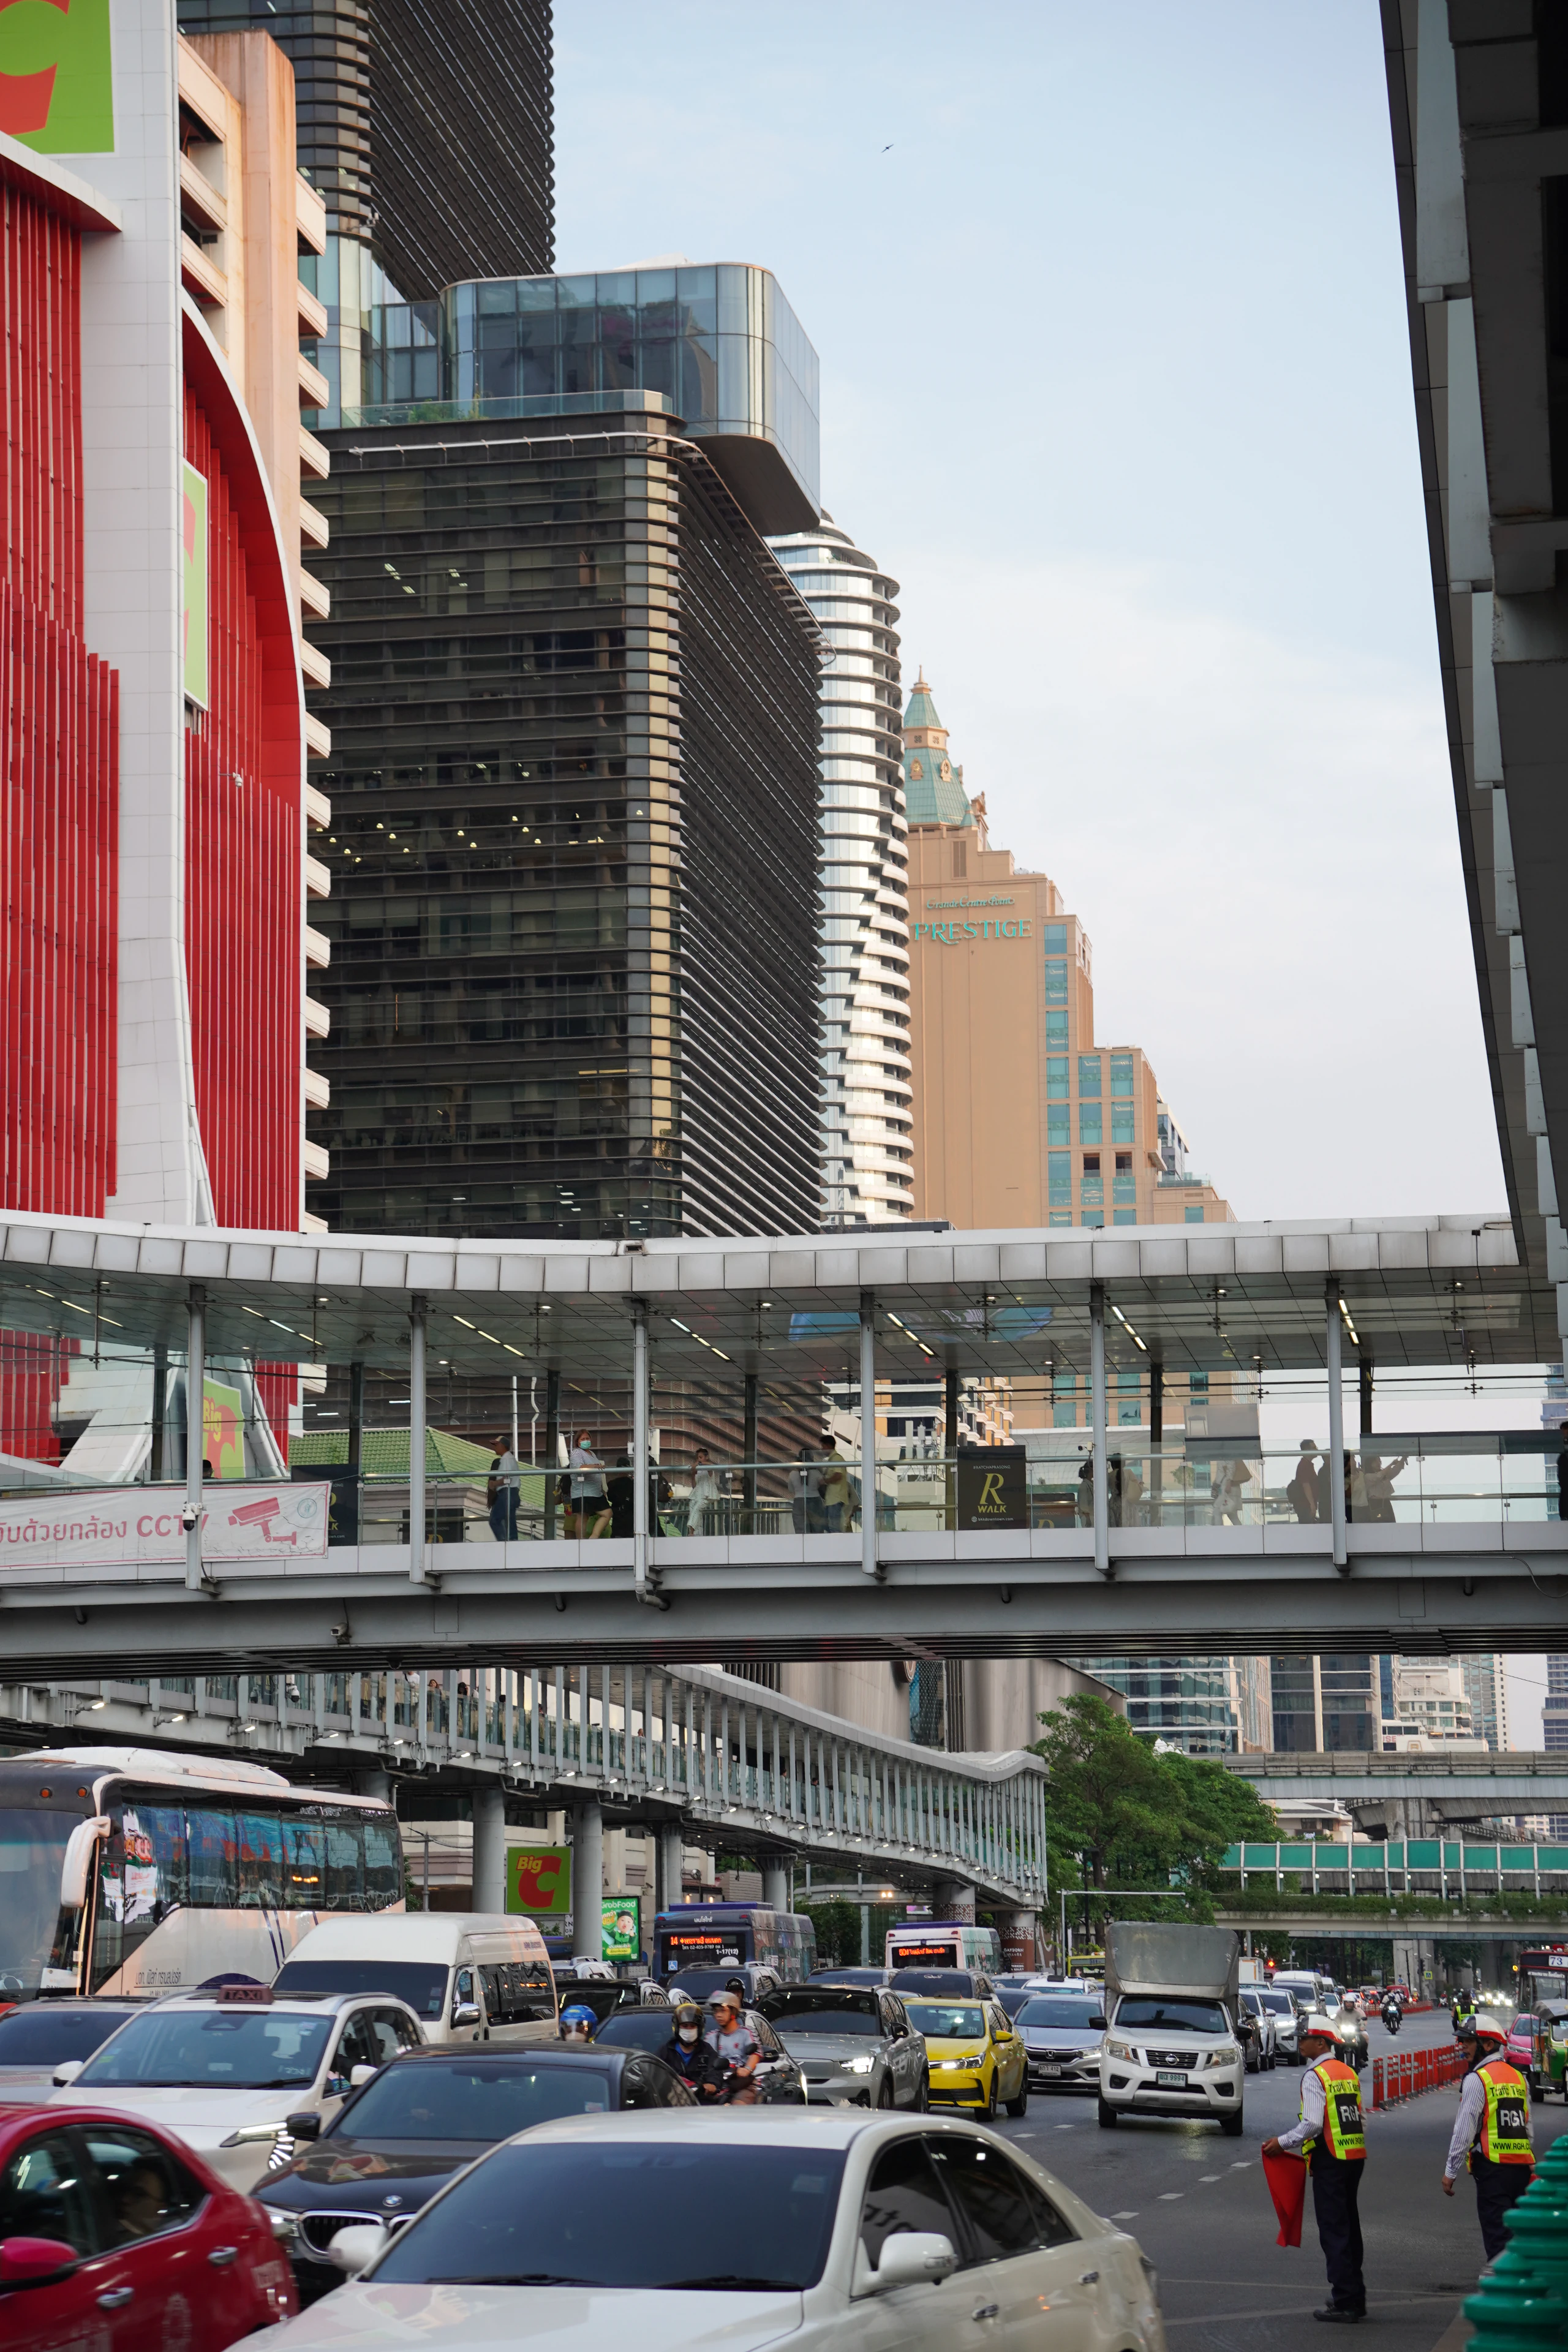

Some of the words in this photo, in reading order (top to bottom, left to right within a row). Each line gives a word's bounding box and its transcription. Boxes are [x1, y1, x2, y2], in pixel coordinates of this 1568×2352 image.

[927, 897, 959, 909] Grande
[959, 895, 987, 908] Centre
[988, 894, 1015, 906] Point
[911, 919, 1032, 945] PRESTIGE
[979, 1473, 1005, 1504] R
[517, 1856, 543, 1874] Big
[518, 1855, 562, 1908] C
[670, 1936, 678, 1945] 14
[1550, 1957, 1562, 1966] 73
[225, 1990, 262, 2000] TAXI
